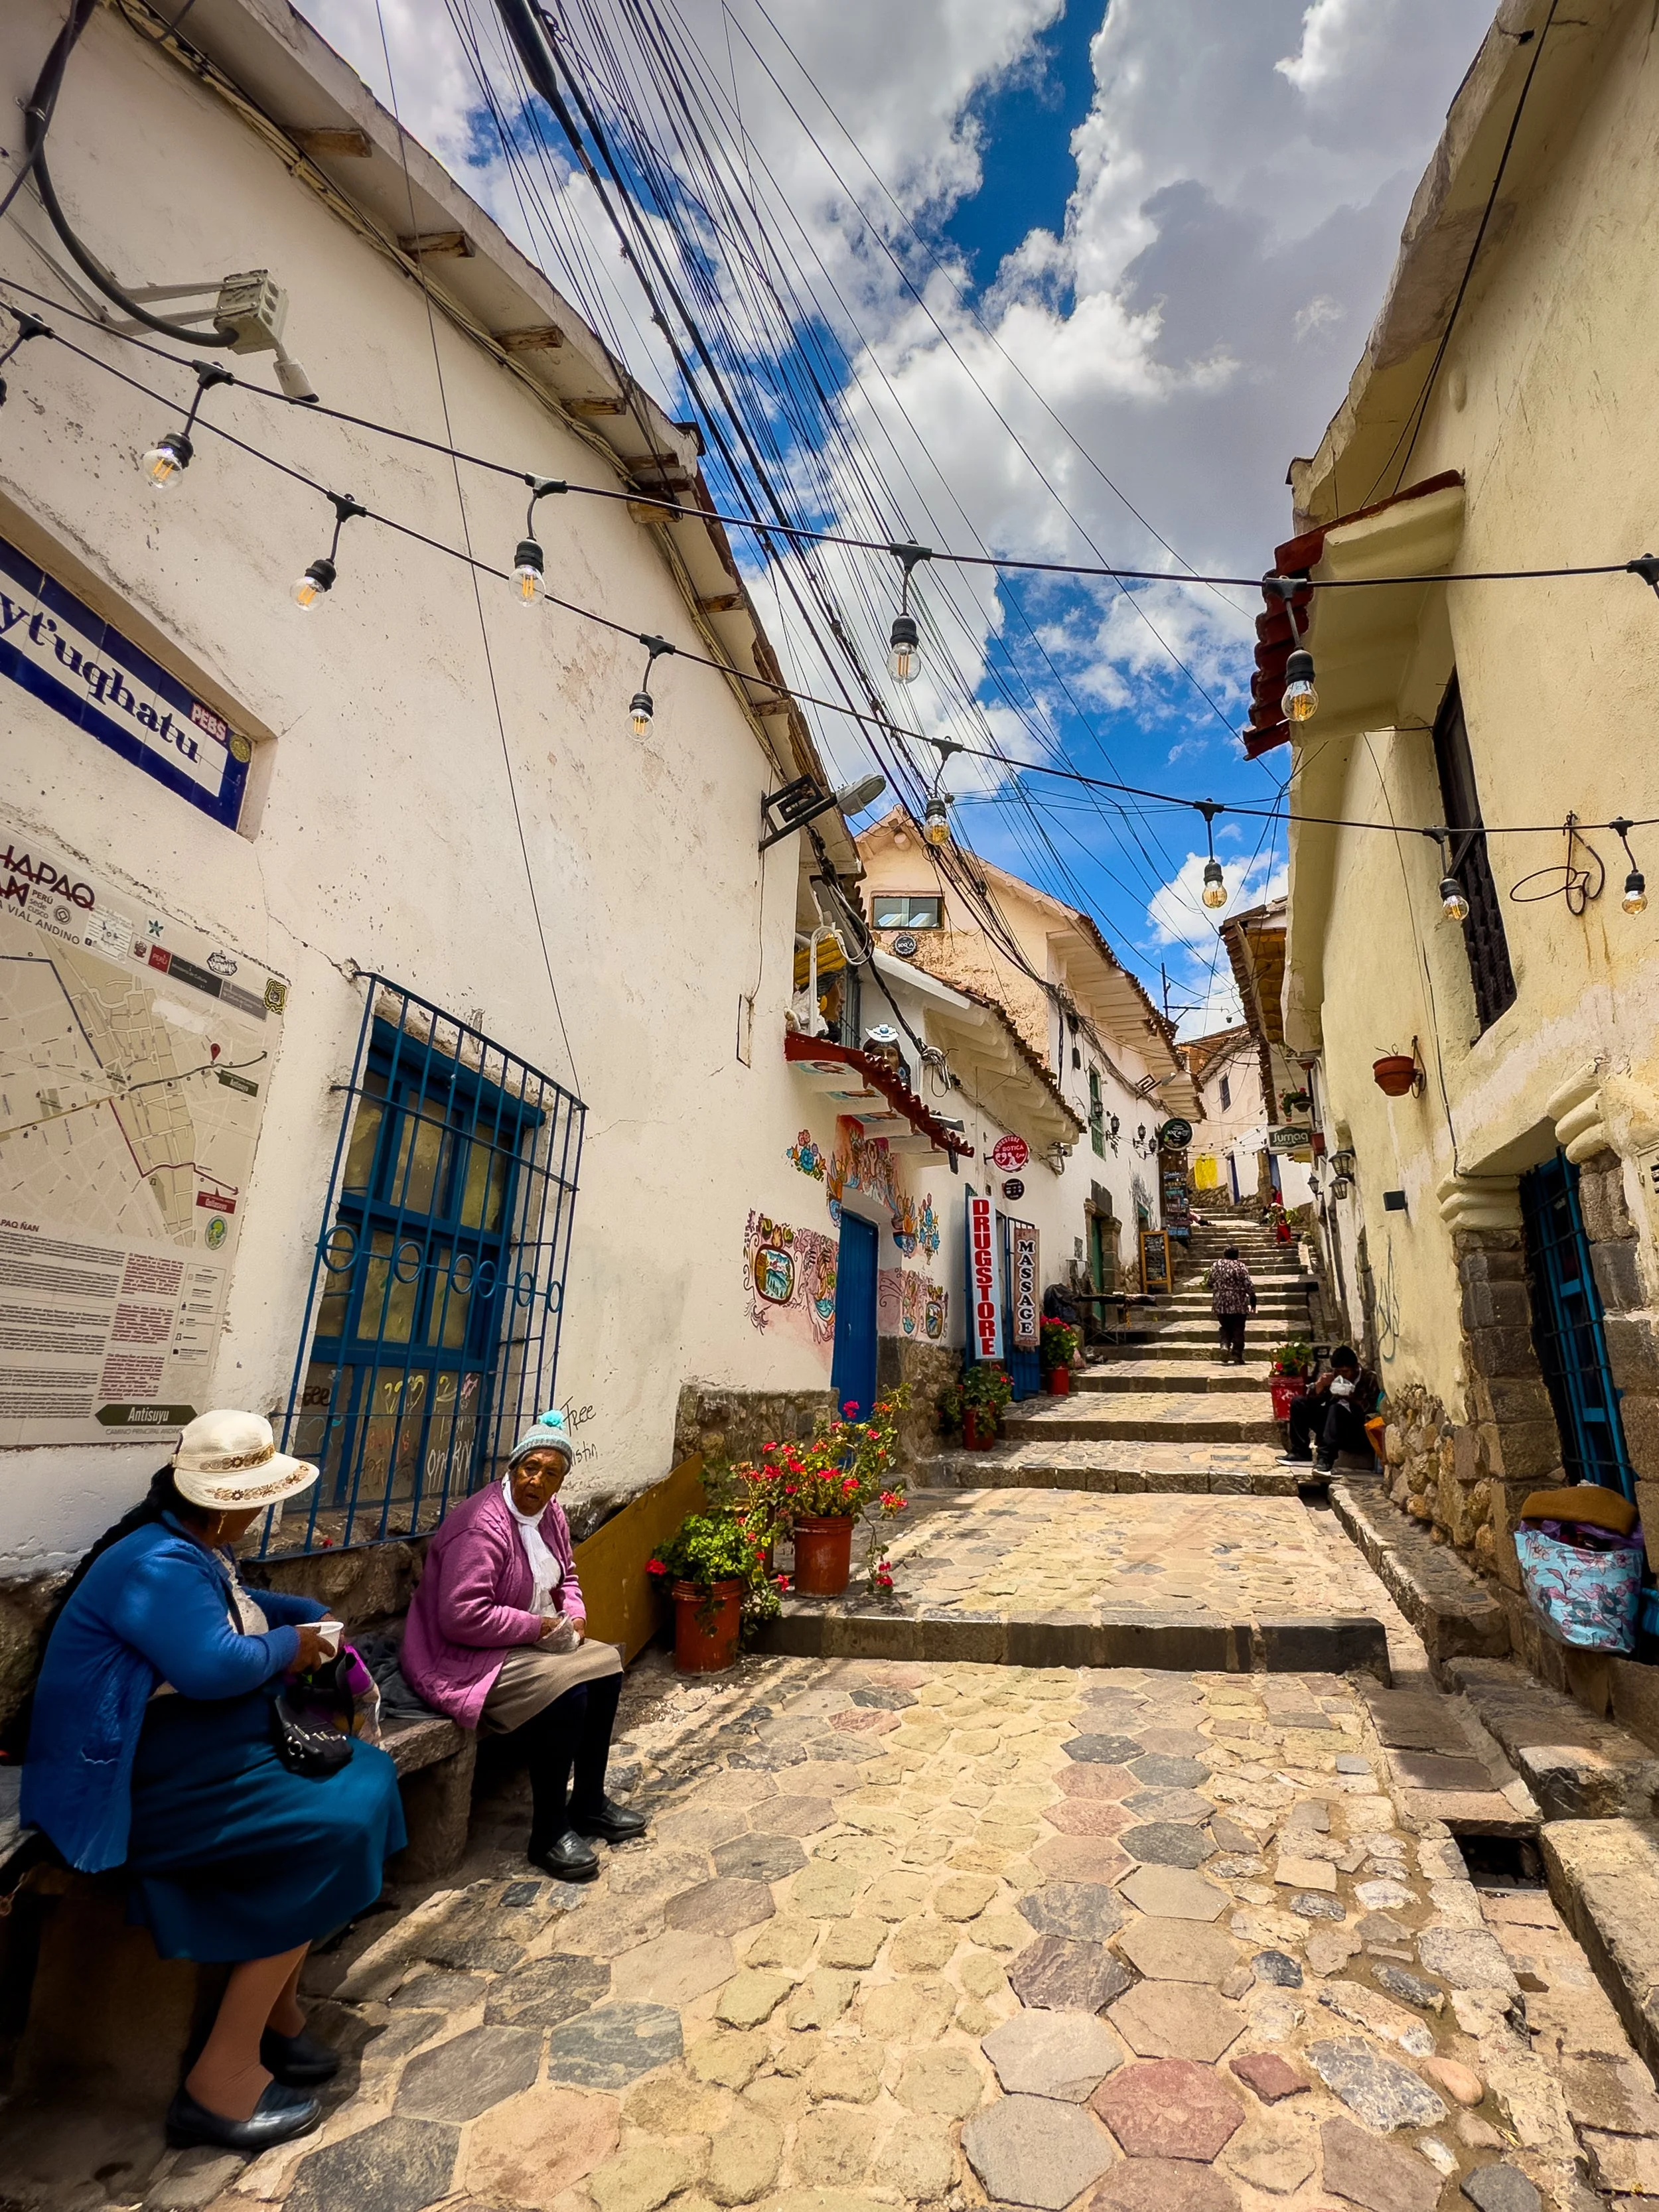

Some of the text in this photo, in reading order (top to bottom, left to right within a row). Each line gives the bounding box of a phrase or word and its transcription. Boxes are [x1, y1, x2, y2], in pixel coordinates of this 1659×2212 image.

[32, 890, 53, 905] PERÚ
[8, 904, 80, 945] VIAL ANDINO
[0, 1219, 40, 1232] PAQ ÑAN
[972, 1199, 995, 1355] DRUGSTORE
[1018, 1239, 1035, 1336] MASSAGE
[127, 1407, 170, 1424] Antisuyu
